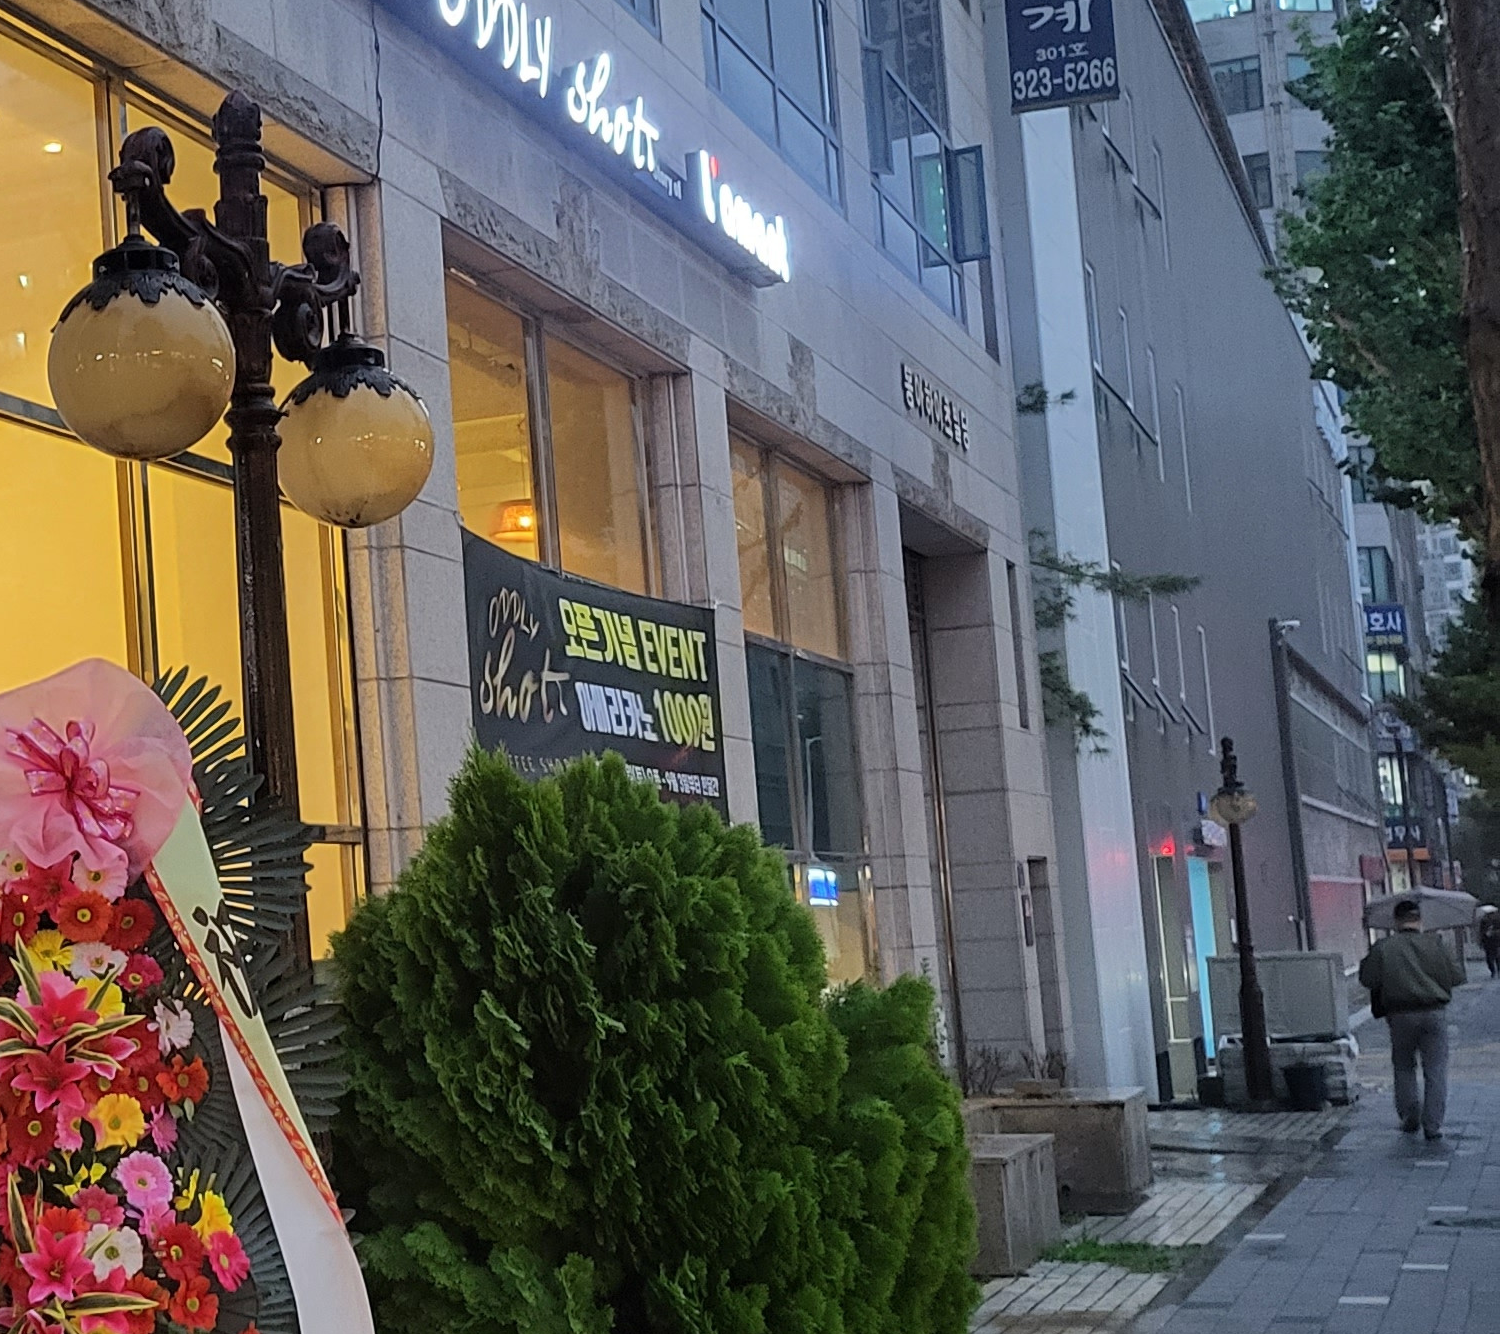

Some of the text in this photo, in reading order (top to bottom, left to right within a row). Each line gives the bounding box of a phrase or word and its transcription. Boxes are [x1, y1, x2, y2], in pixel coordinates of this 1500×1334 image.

[1013, 57, 1117, 101] 323-5266
[1035, 41, 1089, 62] 301호
[567, 51, 660, 172] shot
[487, 586, 540, 642] ODDLY
[558, 597, 708, 682] 오픈기념 EVENT
[478, 626, 571, 724] shot
[575, 681, 660, 742] 아메리카노
